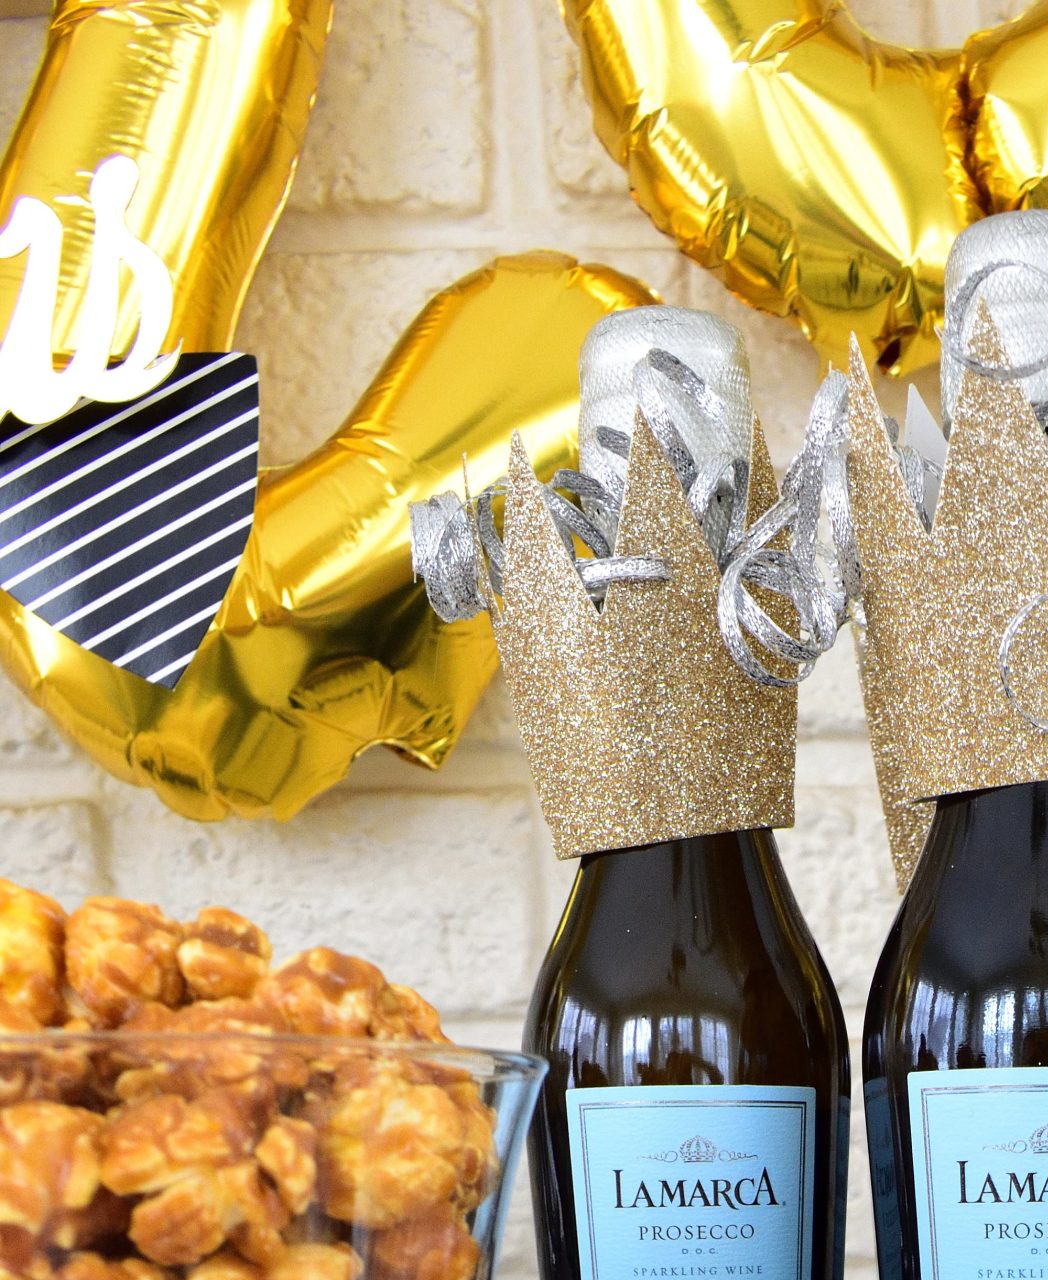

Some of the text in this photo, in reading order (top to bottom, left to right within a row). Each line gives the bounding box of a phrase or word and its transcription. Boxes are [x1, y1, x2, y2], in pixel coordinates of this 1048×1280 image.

[638, 1223, 756, 1241] PROSECCO
[632, 1265, 764, 1277] SPARKLING WINE
